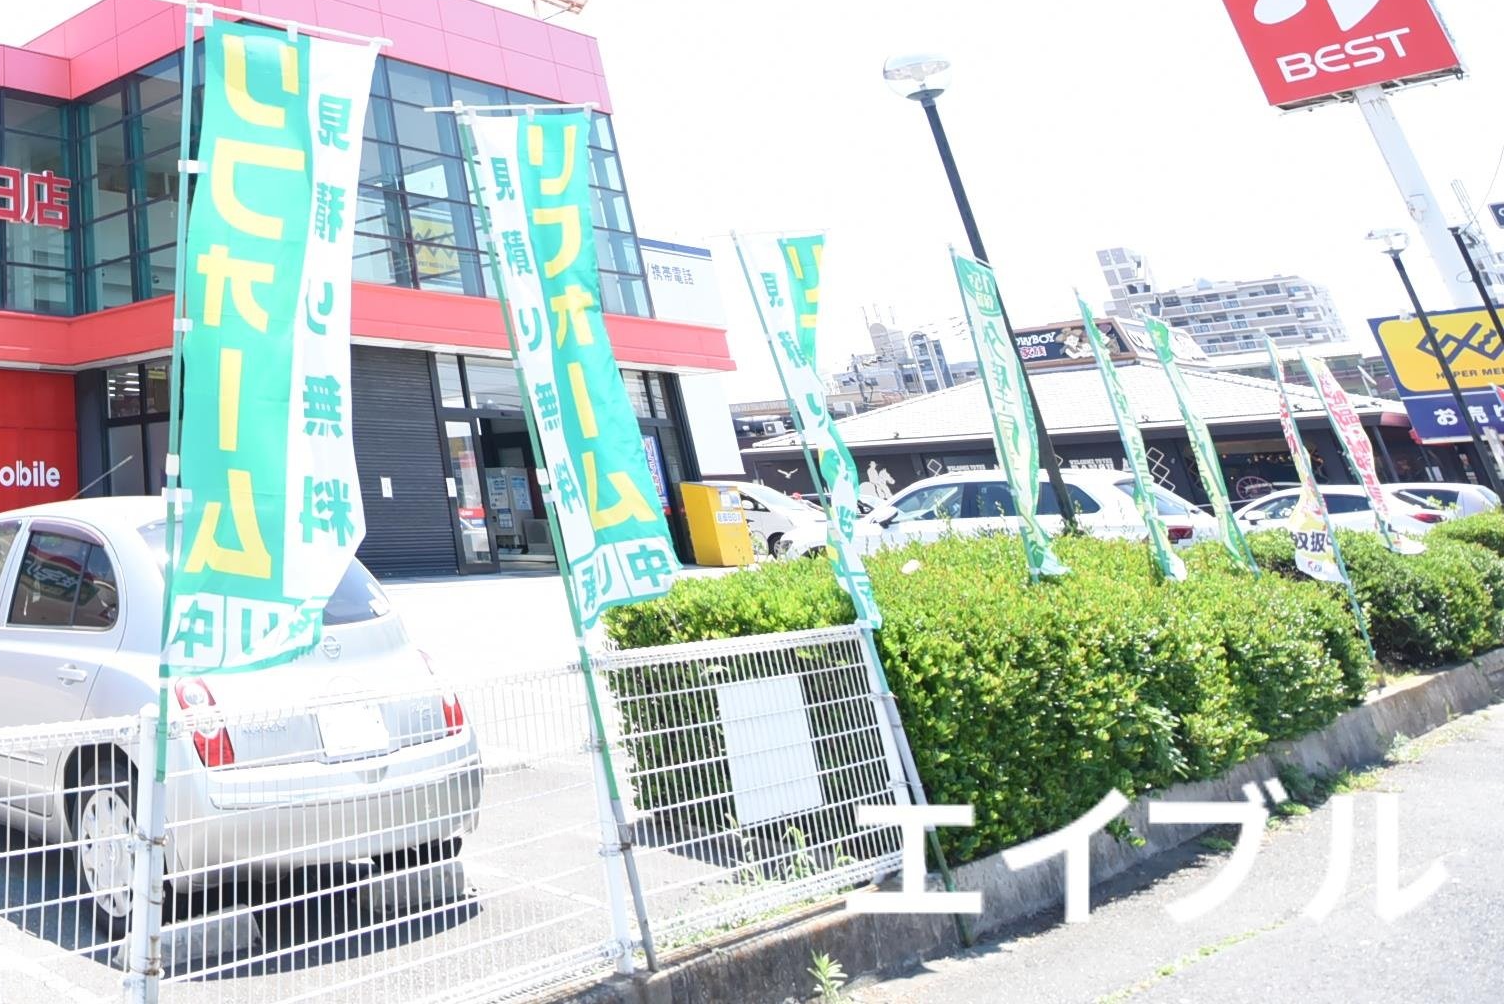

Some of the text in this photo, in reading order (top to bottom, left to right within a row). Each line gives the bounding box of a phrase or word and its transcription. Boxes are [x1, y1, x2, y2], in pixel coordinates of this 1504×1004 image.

[1276, 27, 1410, 83] BEST
[527, 124, 659, 532] リフォーム
[1015, 331, 1056, 346] OWBOY
[1436, 369, 1479, 381] HPER
